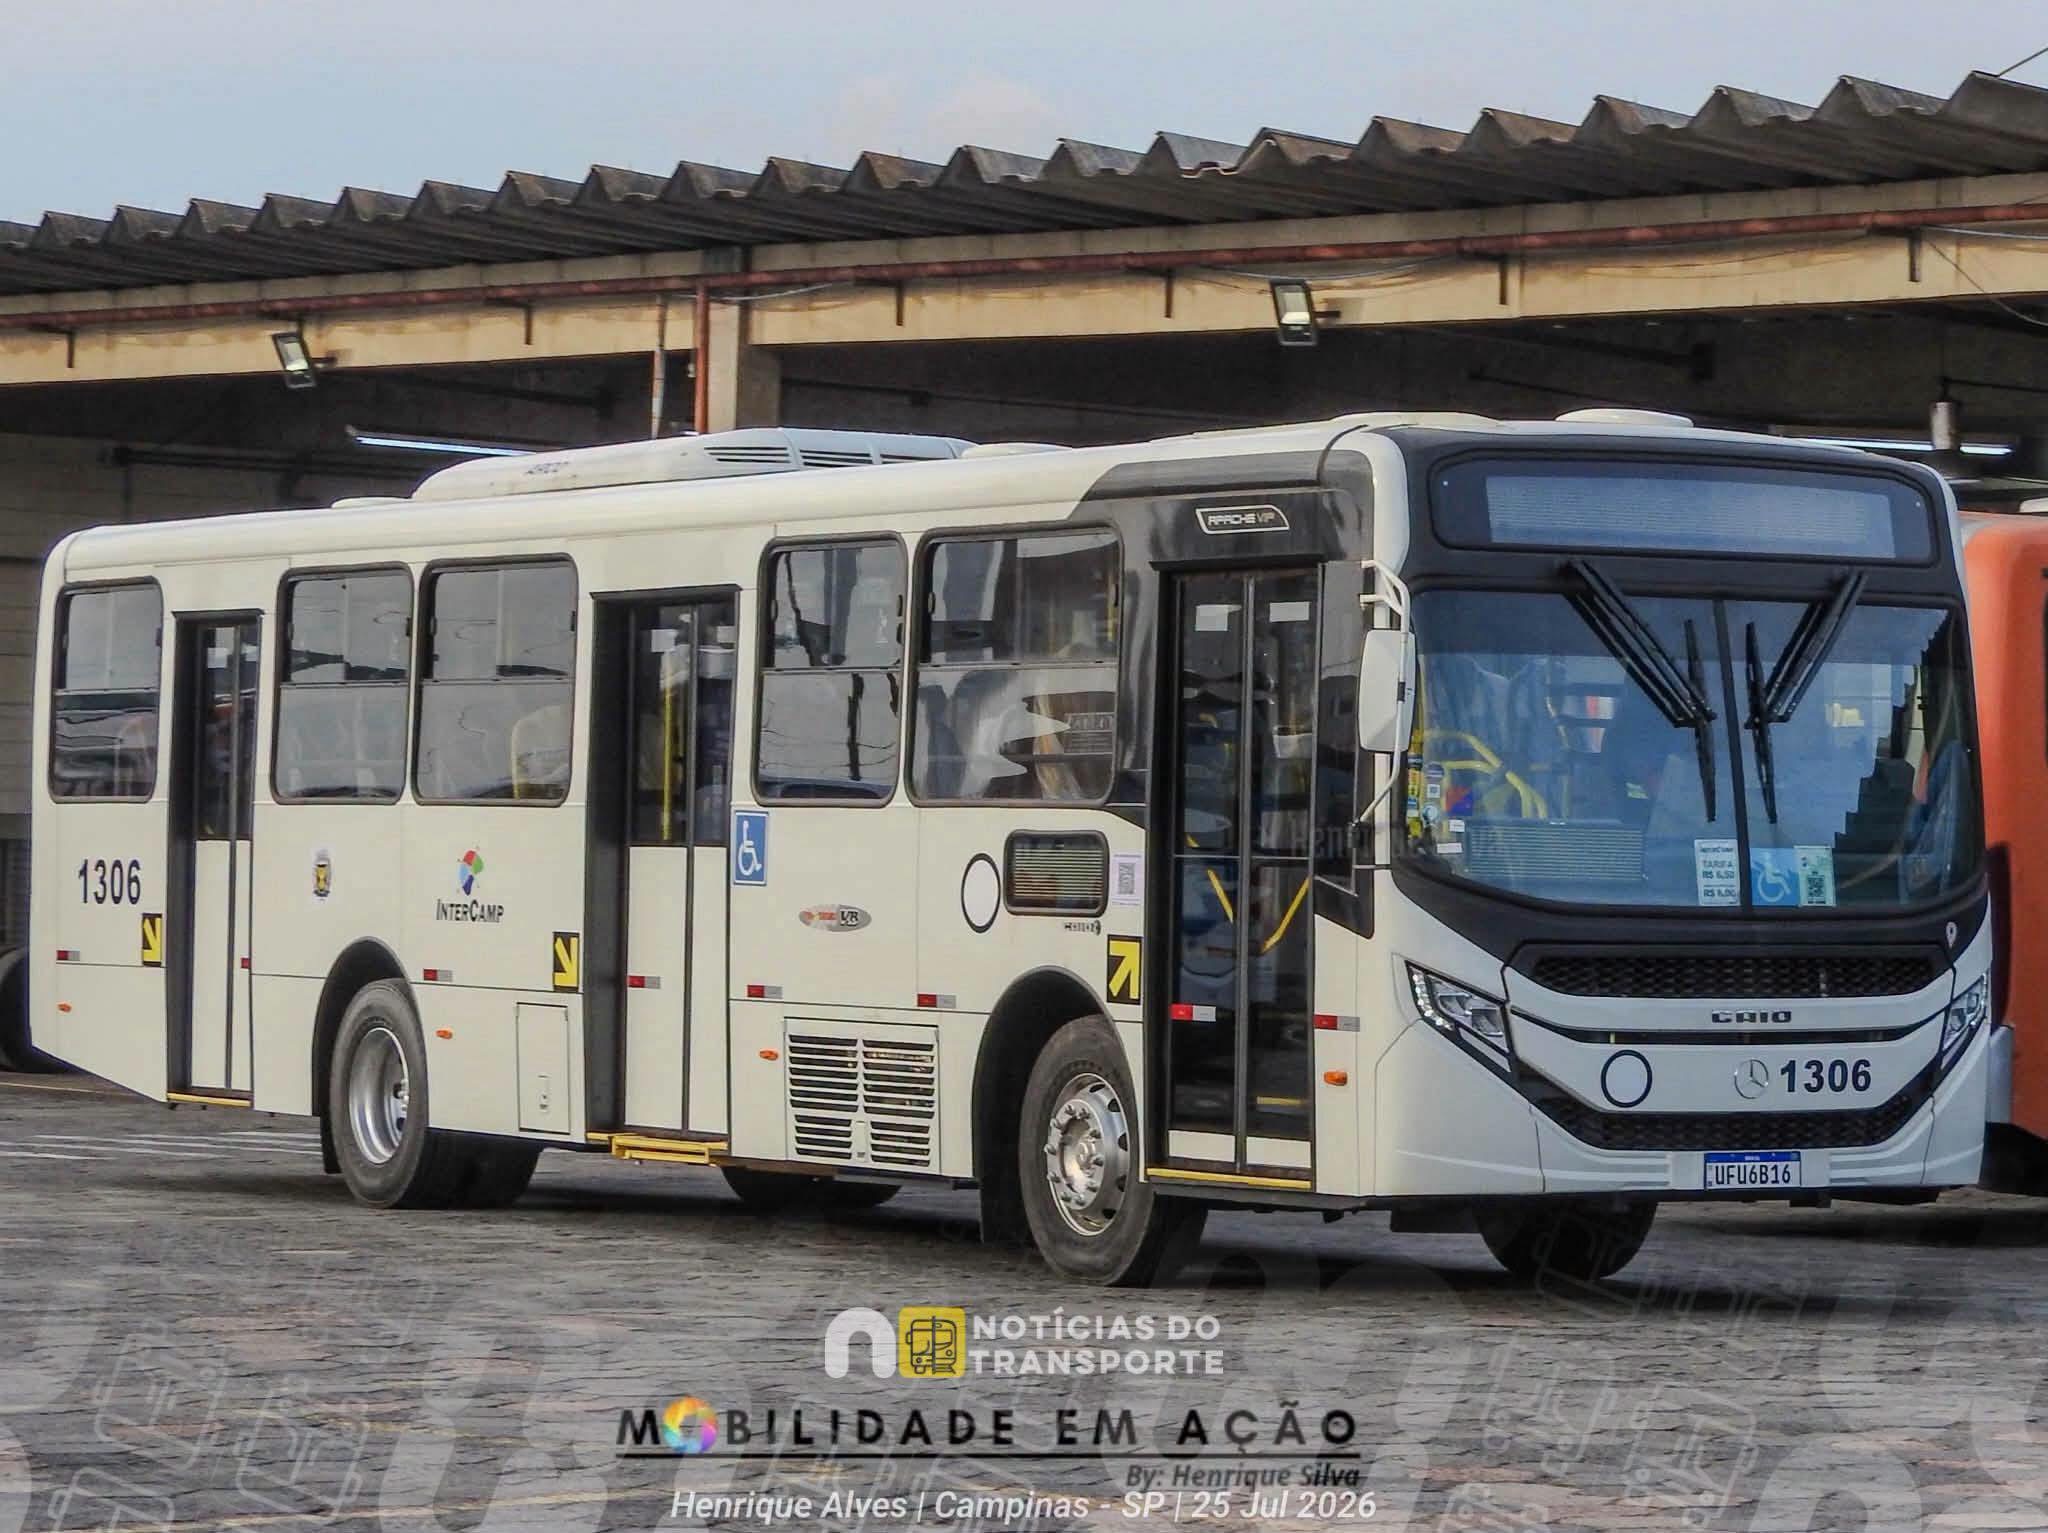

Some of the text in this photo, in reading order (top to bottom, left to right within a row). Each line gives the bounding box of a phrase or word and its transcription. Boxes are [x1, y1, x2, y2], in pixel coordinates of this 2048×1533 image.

[78, 858, 141, 905] 1306
[1711, 1010, 1792, 1024] CAIO
[1780, 1058, 1872, 1093] 1306
[1714, 1163, 1792, 1186] UFU6B16
